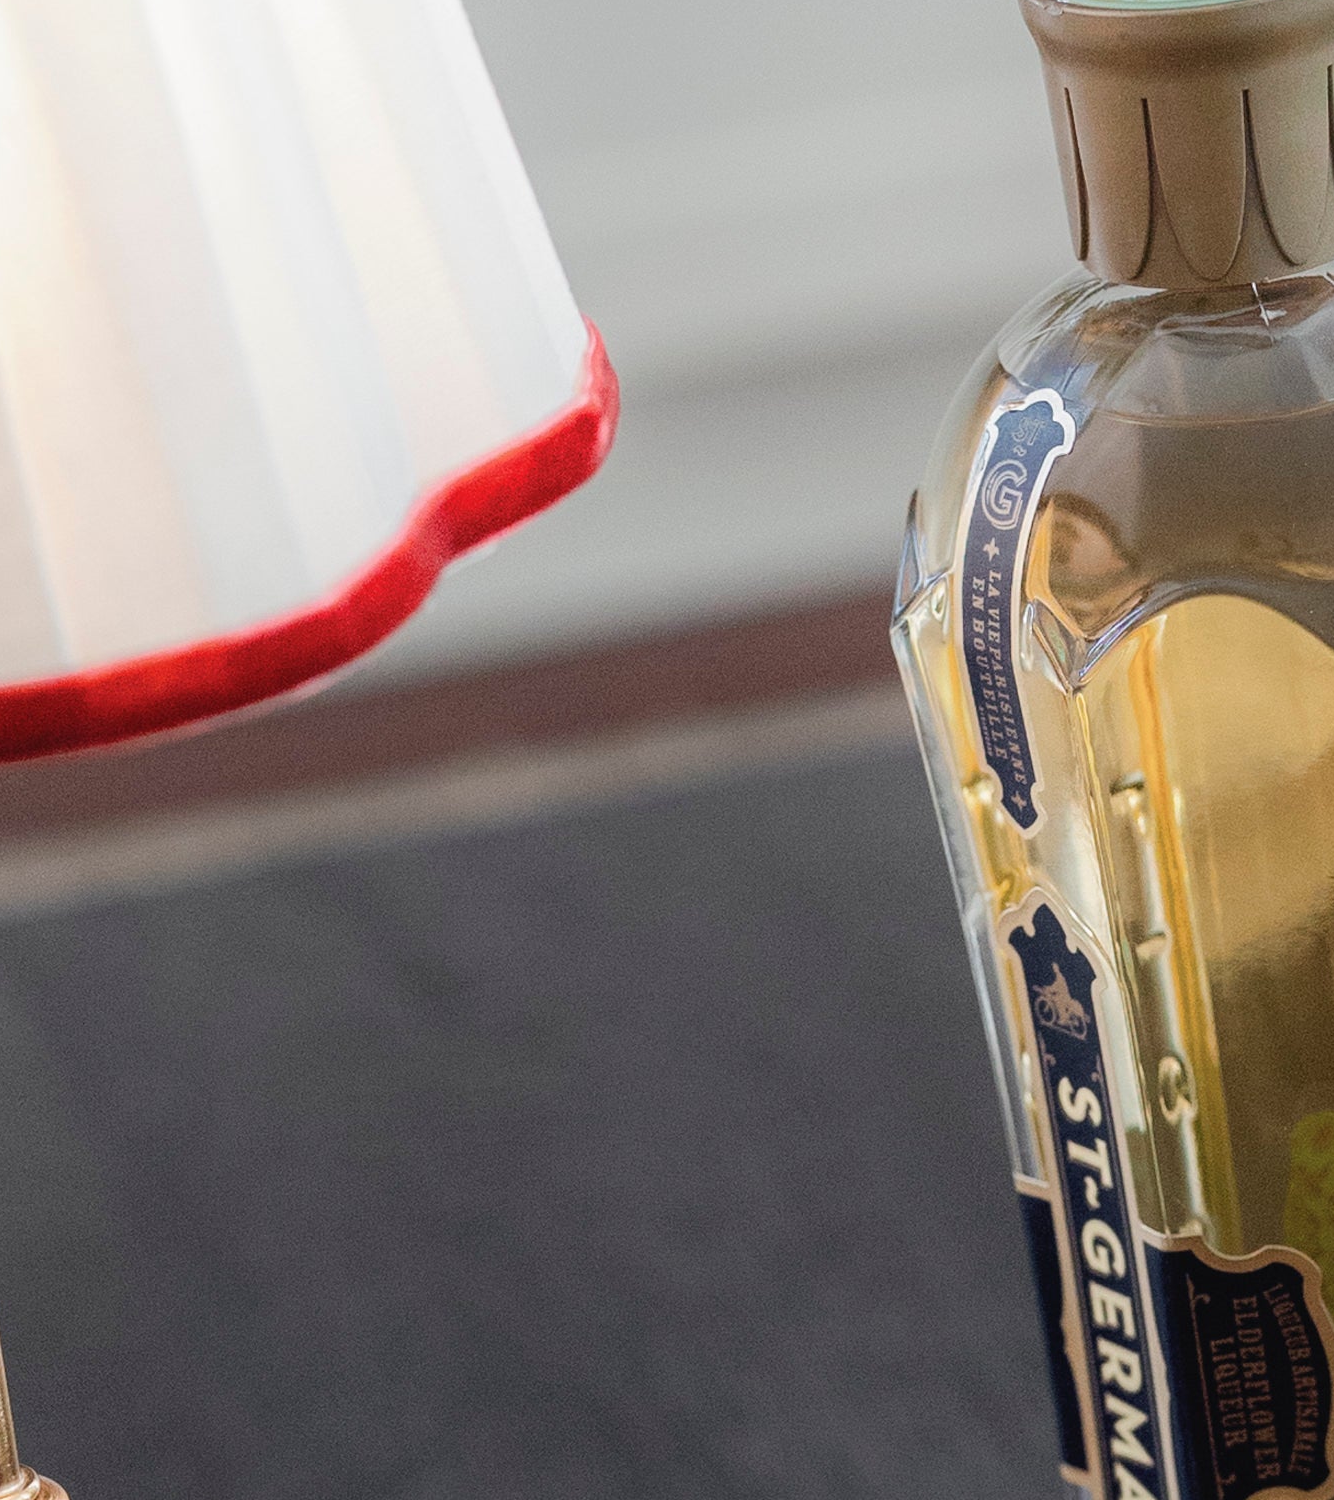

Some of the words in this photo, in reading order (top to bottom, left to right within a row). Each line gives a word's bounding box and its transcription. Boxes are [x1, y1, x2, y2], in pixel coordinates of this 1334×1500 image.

[1011, 417, 1046, 446] ST
[981, 459, 1028, 531] G
[971, 576, 986, 612] EN
[987, 569, 1002, 598] LA
[987, 607, 1002, 644] VIE
[971, 618, 1009, 760] BOUTEILLE
[988, 645, 1028, 786] PARISIENNE
[1263, 1282, 1312, 1361] LIQUEUR
[1211, 1337, 1247, 1447] LIQUEUR
[1234, 1297, 1280, 1478] ELDERFLOWER
